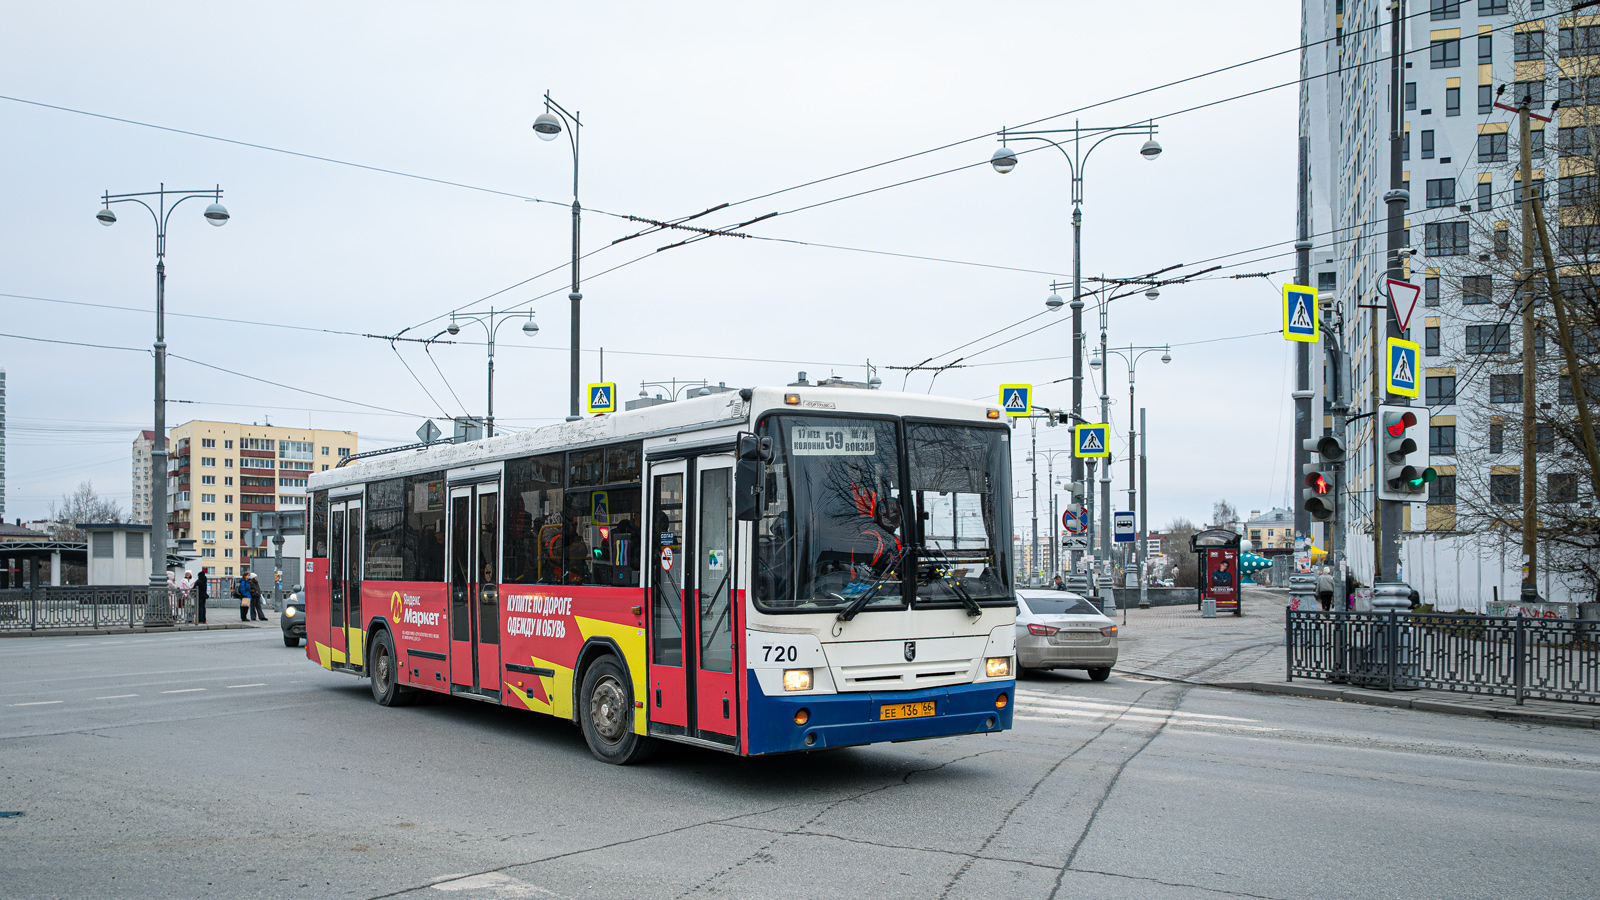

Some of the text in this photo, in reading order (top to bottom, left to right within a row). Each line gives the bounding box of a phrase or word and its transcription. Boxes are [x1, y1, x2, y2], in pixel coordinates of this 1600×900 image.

[798, 429, 805, 439] 17
[825, 431, 844, 450] 59
[793, 441, 826, 450] КОЛОННА
[845, 442, 875, 452] ВОКЗАЛ
[403, 593, 421, 607] Яндекс
[506, 594, 573, 617] КУПИТЕ ПО ДОРОГЕ
[403, 608, 440, 627] Маркет
[507, 616, 566, 639] ОДЕЖДУ И ОБУВЬ
[762, 645, 798, 662] 720
[900, 704, 918, 717] 136
[922, 702, 932, 712] 66
